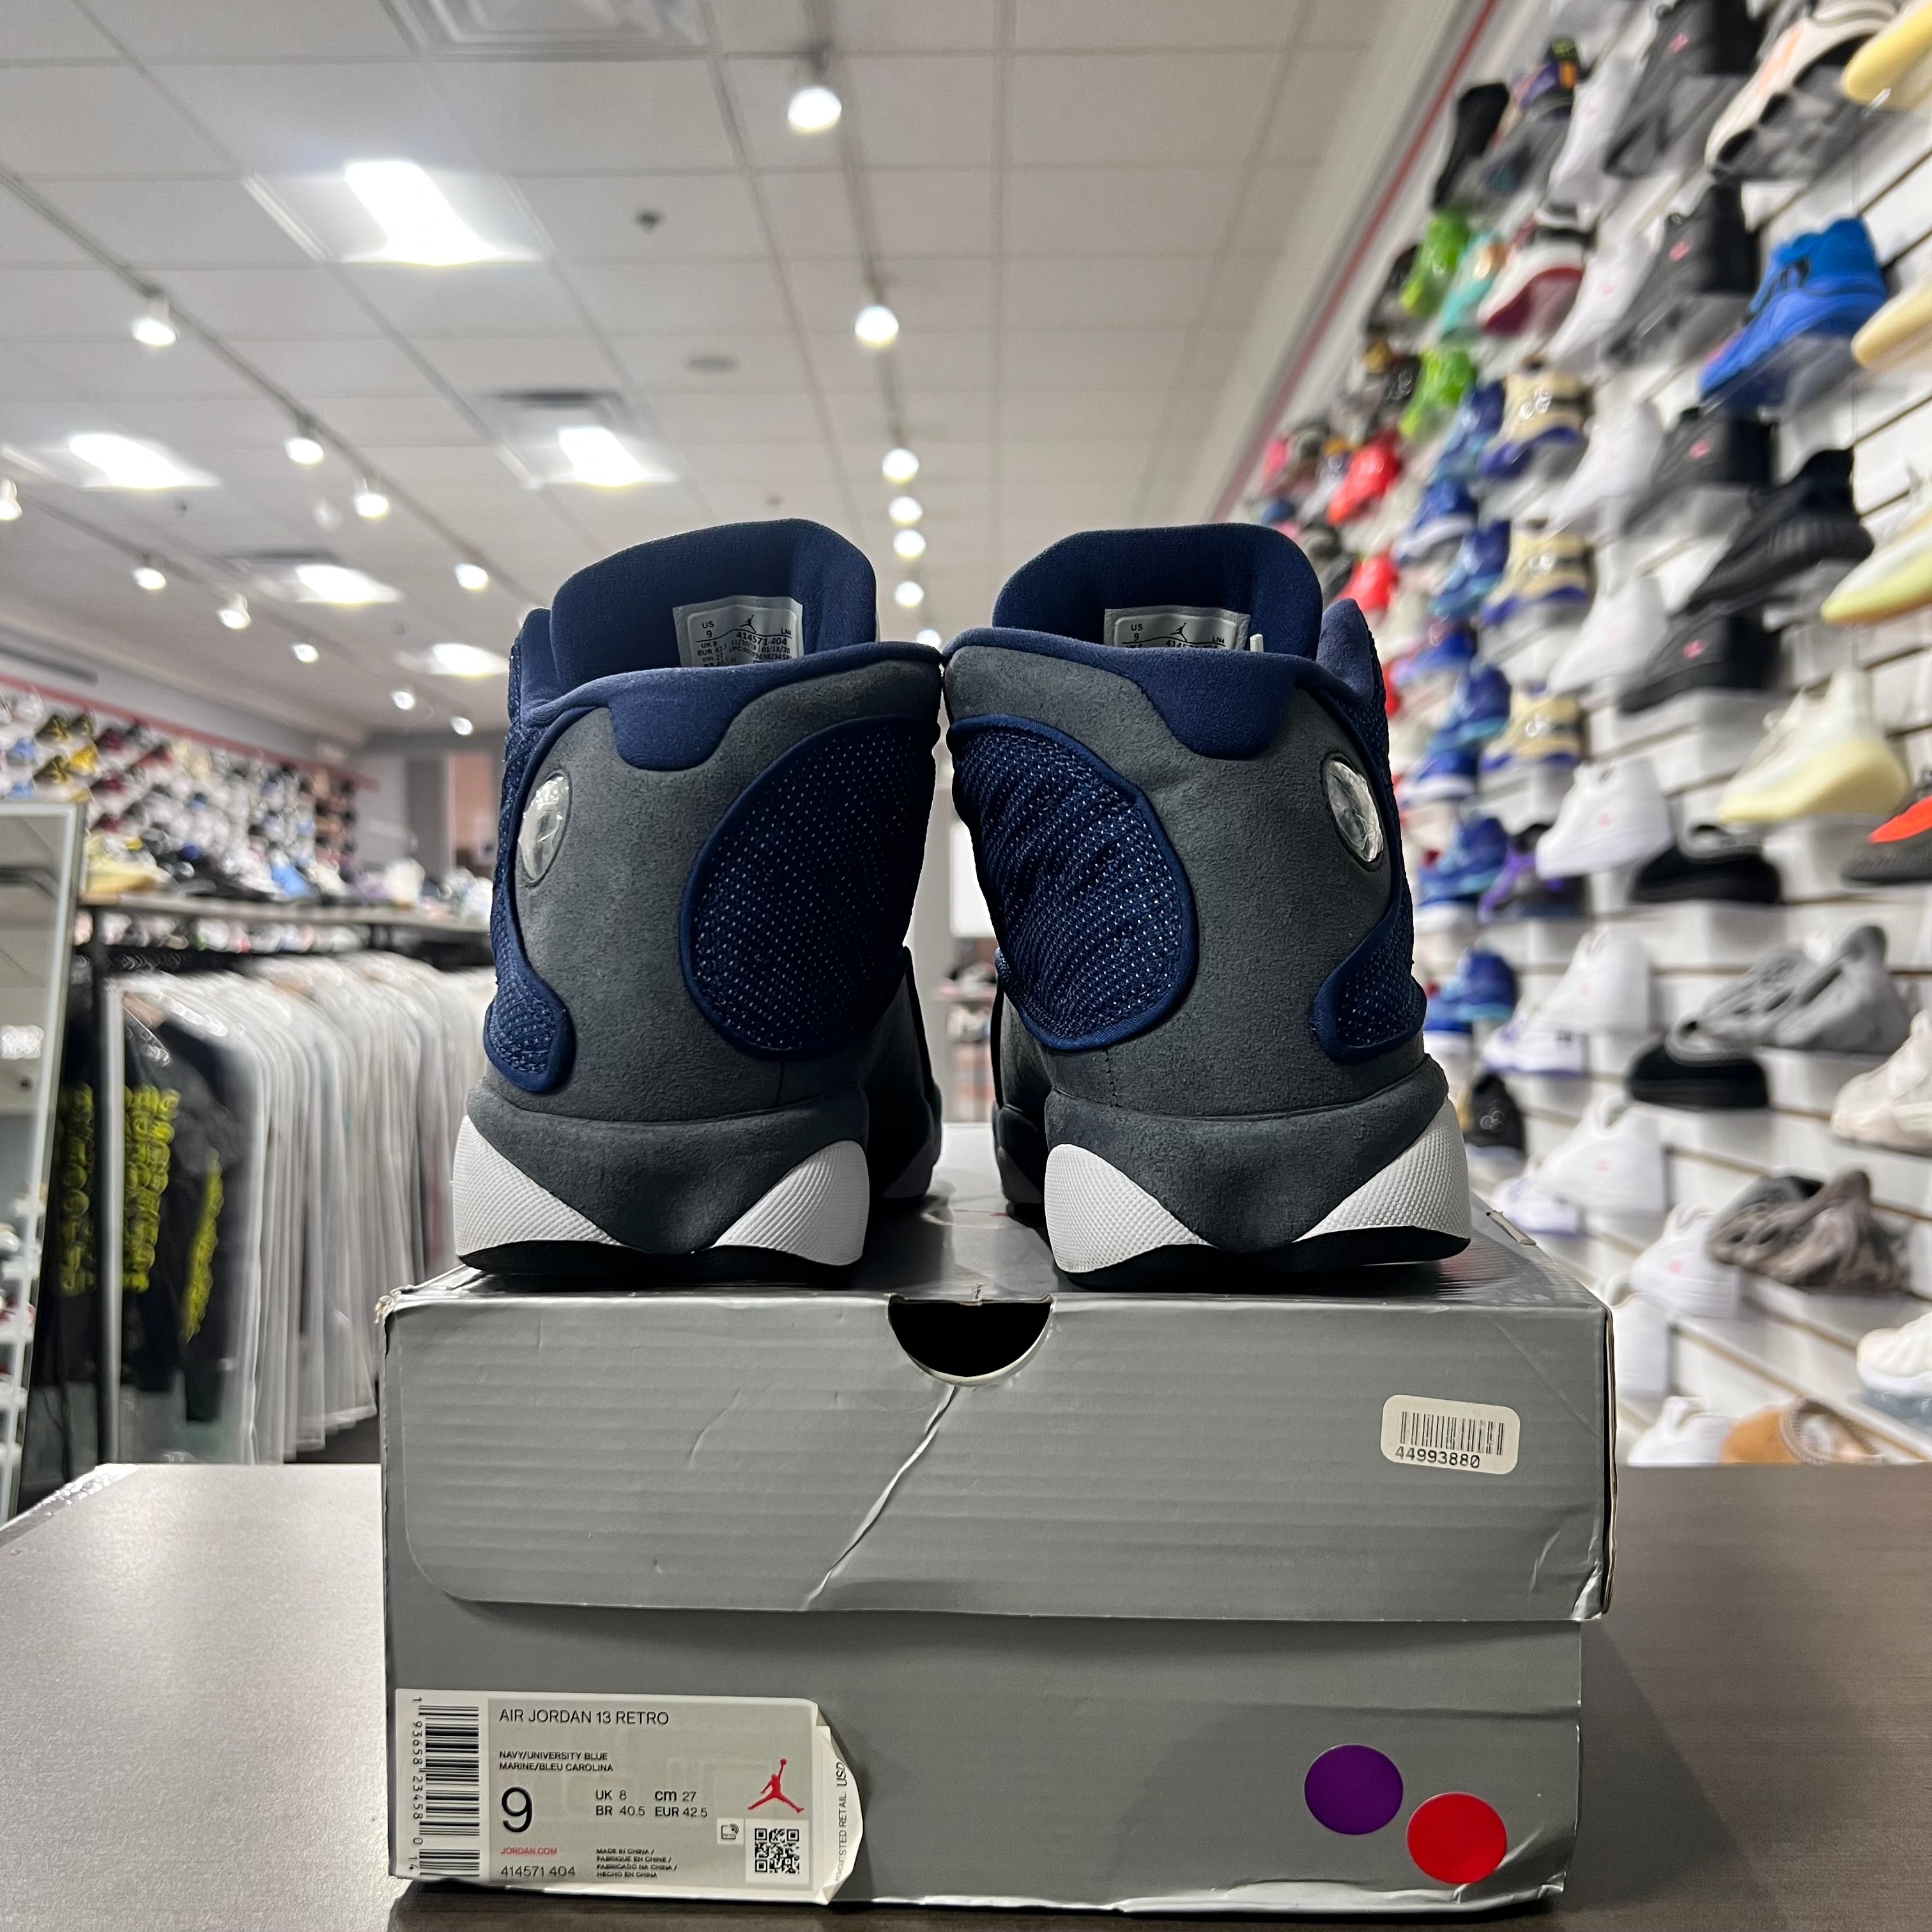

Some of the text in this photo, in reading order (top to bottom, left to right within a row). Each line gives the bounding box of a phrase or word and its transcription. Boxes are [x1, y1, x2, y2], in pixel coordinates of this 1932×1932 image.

[706, 630, 712, 639] 9
[1133, 632, 1139, 641] 9
[1212, 636, 1225, 644] LN4
[716, 652, 723, 661] 27
[1395, 1446, 1480, 1469] 44993880
[500, 1708, 669, 1725] AIR JORDAN 13 RETRO
[413, 1721, 423, 1765] 93658
[499, 1751, 608, 1761] NAVY/UNIVERSITY BLUE
[499, 1763, 613, 1772] MARINE/BLEU CAROLINA
[836, 1761, 848, 1787] USD
[413, 1775, 423, 1820] 23458
[595, 1790, 627, 1800] UK 8
[655, 1791, 696, 1802] cm 27
[501, 1786, 533, 1833] 9
[595, 1805, 645, 1816] BR 40.5
[655, 1806, 708, 1818] EUR 42.5
[501, 1847, 558, 1856] JORDAN.COM
[501, 1866, 576, 1876] 414571 404
